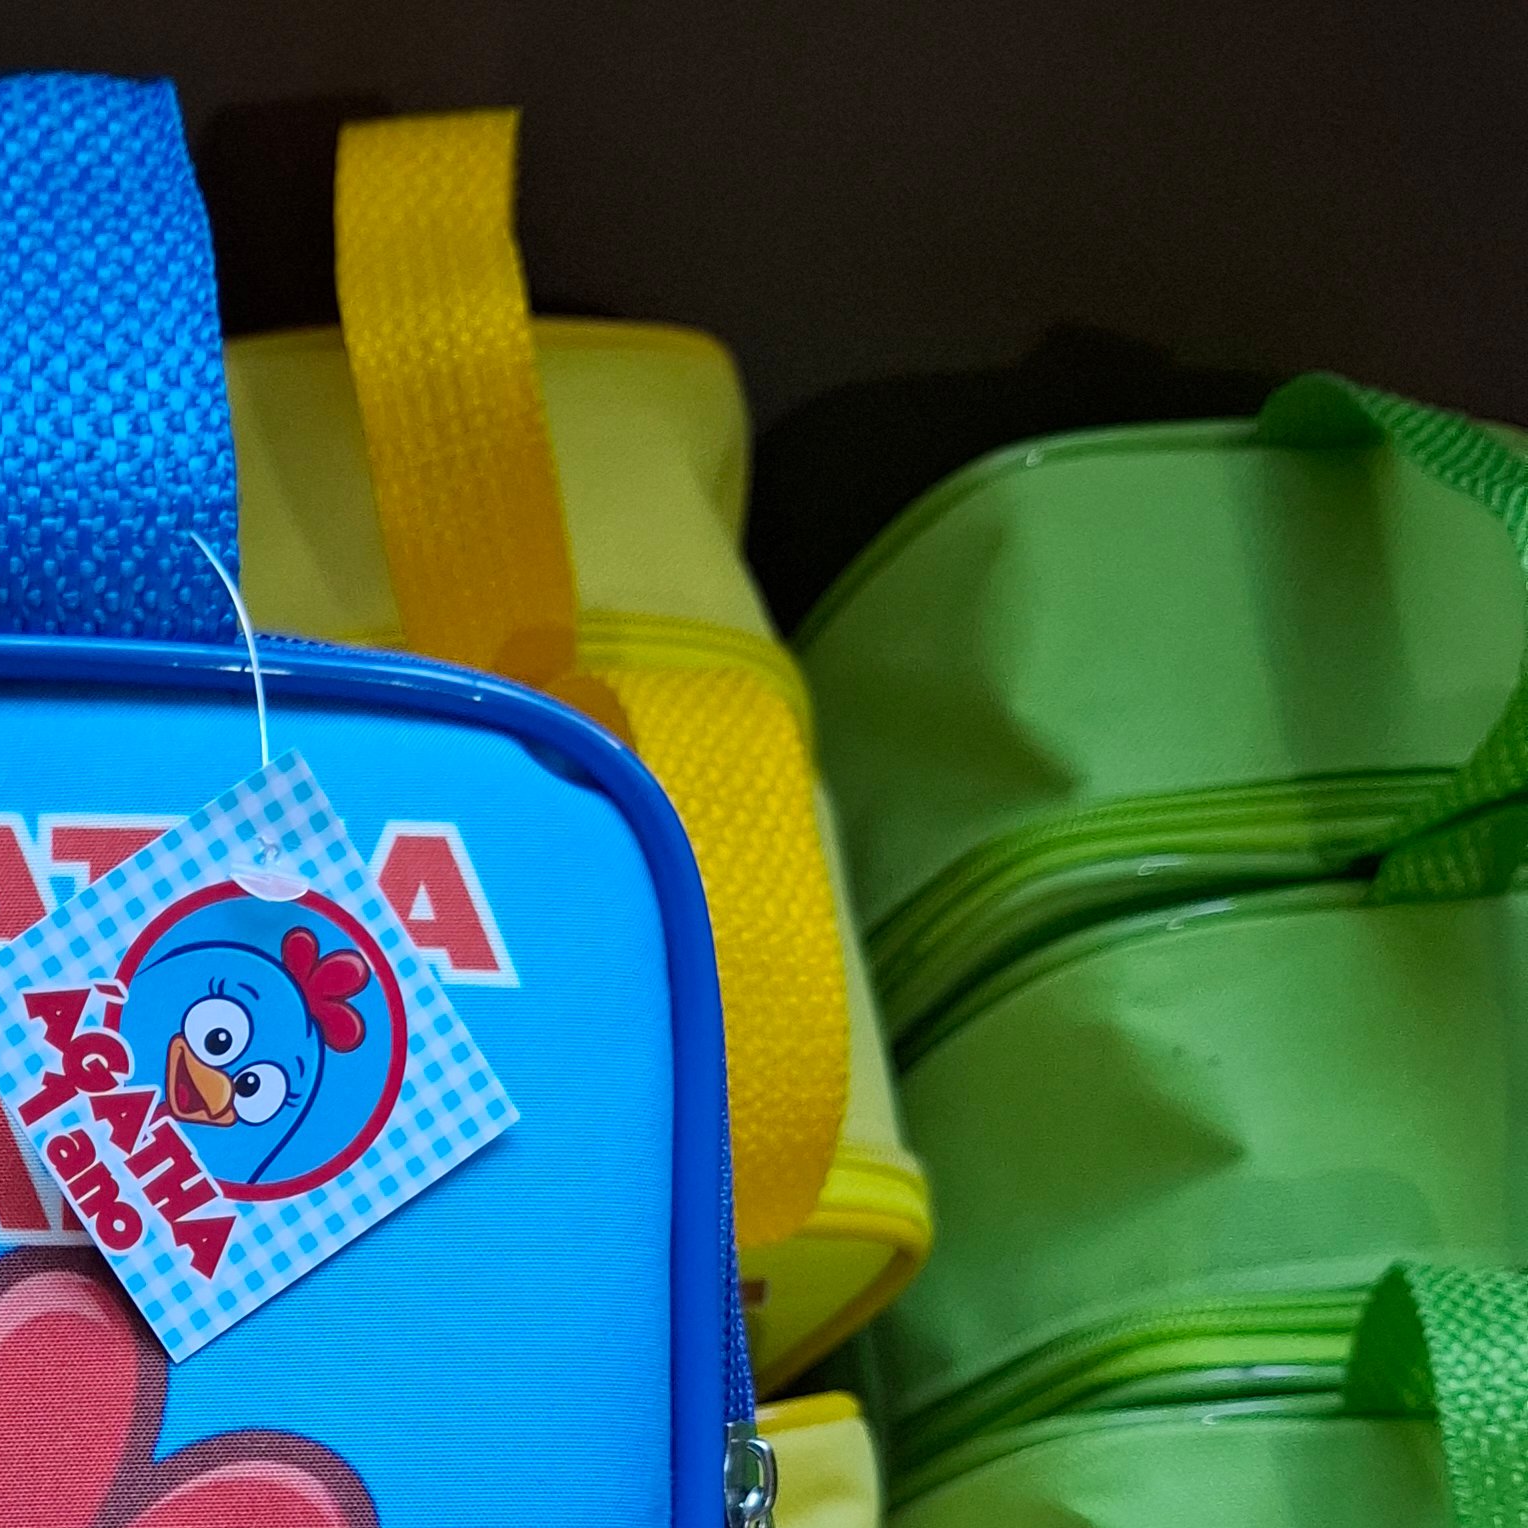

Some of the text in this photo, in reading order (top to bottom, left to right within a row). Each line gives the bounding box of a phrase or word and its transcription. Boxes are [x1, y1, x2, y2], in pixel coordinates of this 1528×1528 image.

[16, 1069, 145, 1253] 1 ano
[21, 982, 239, 1282] ÁGATHA
